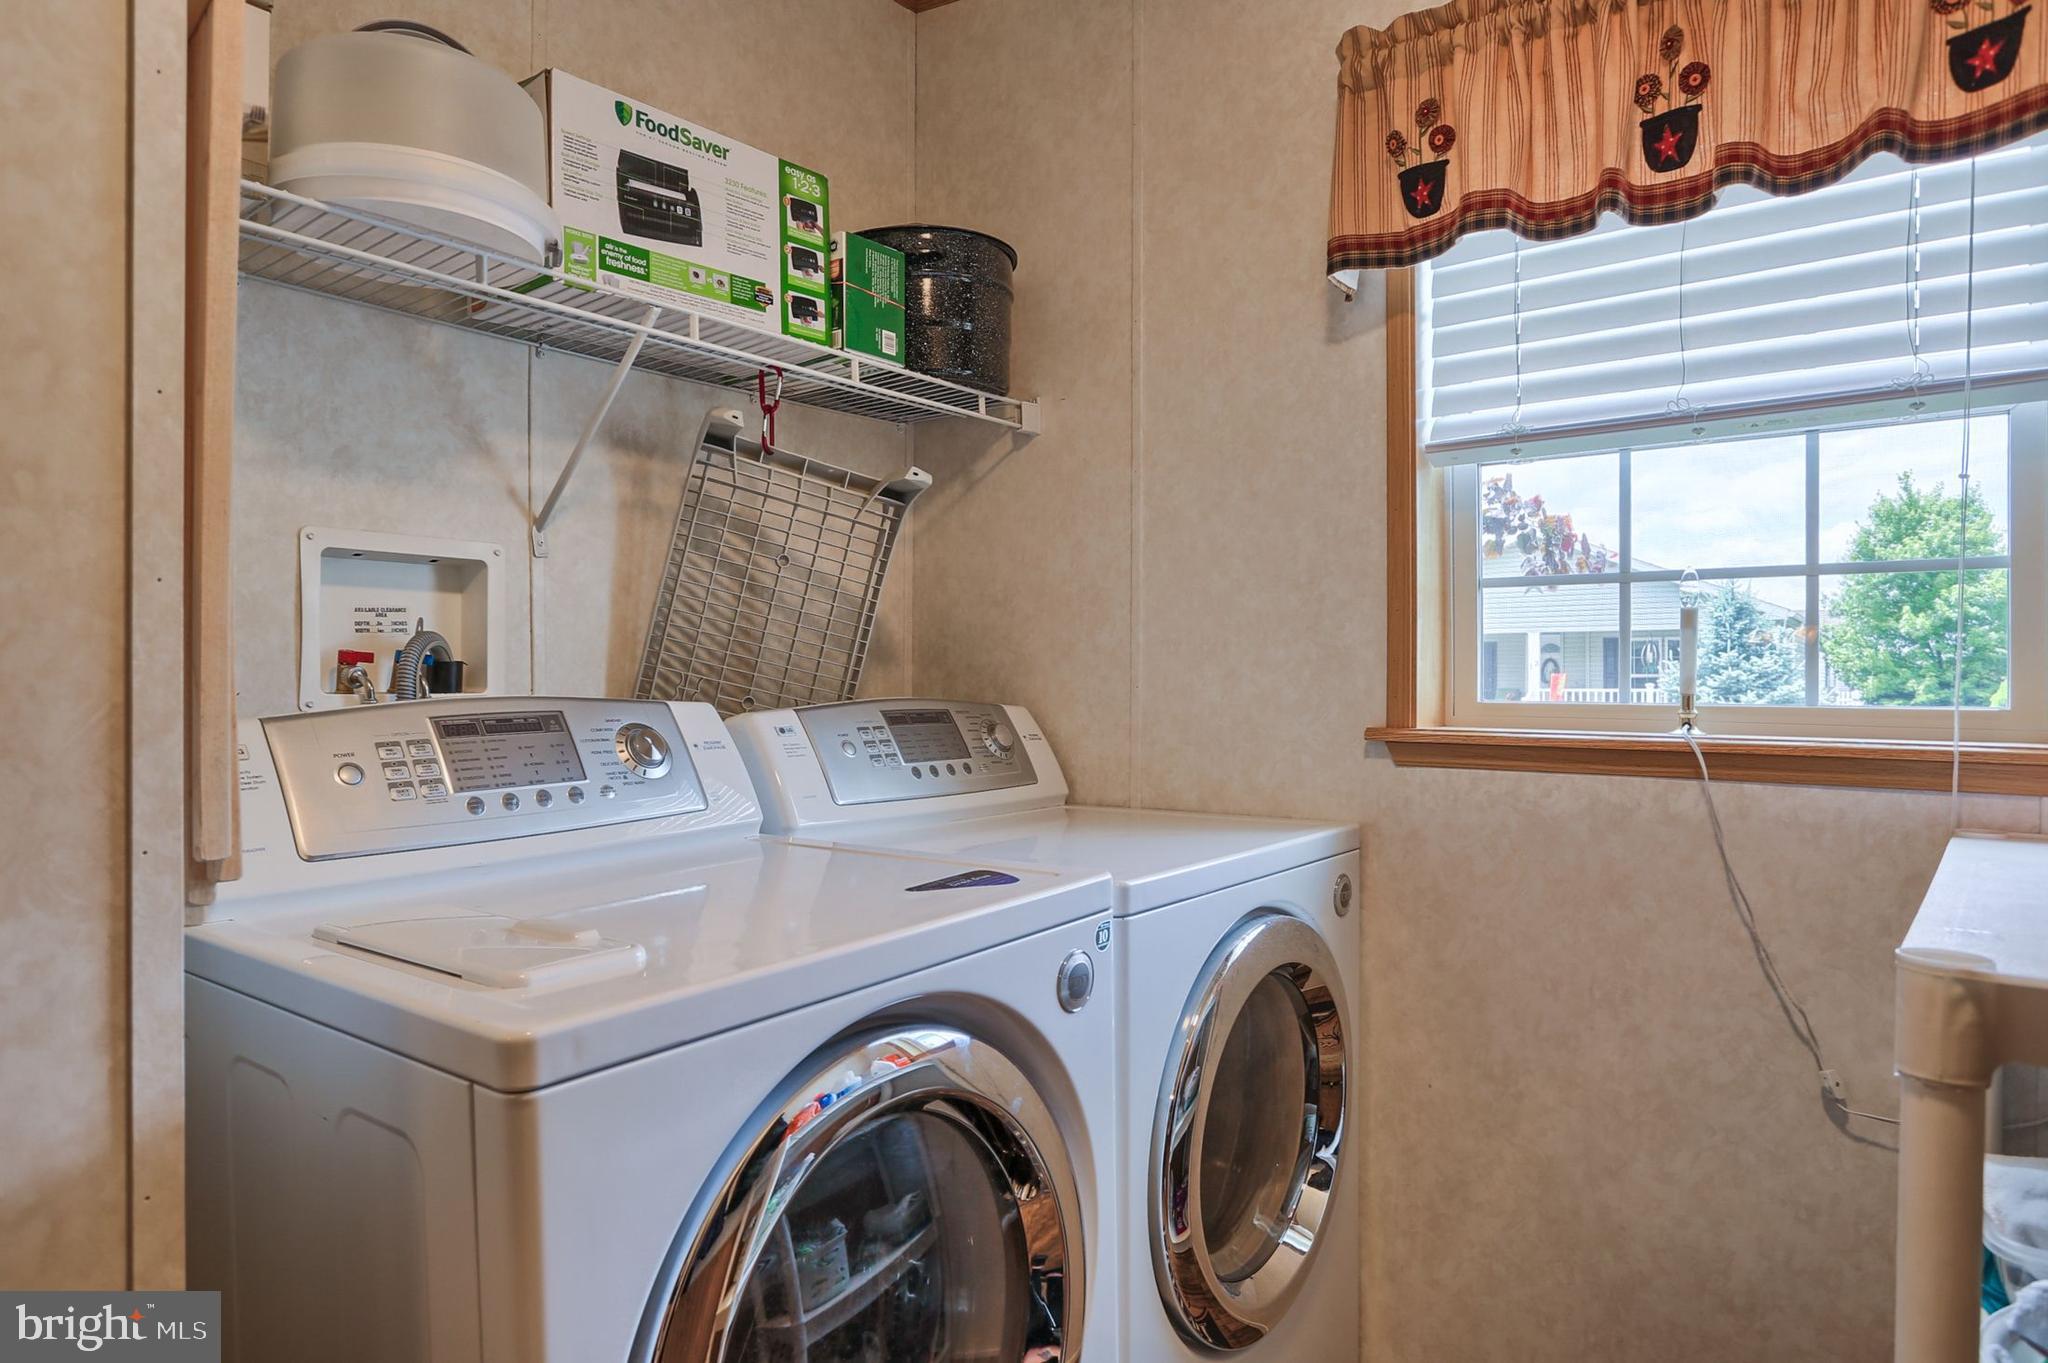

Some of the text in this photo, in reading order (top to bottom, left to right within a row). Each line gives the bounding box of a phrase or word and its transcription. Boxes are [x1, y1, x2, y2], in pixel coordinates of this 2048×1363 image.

[635, 109, 730, 161] FoodSaver
[785, 166, 817, 183] easy as
[1098, 929, 1108, 943] 10
